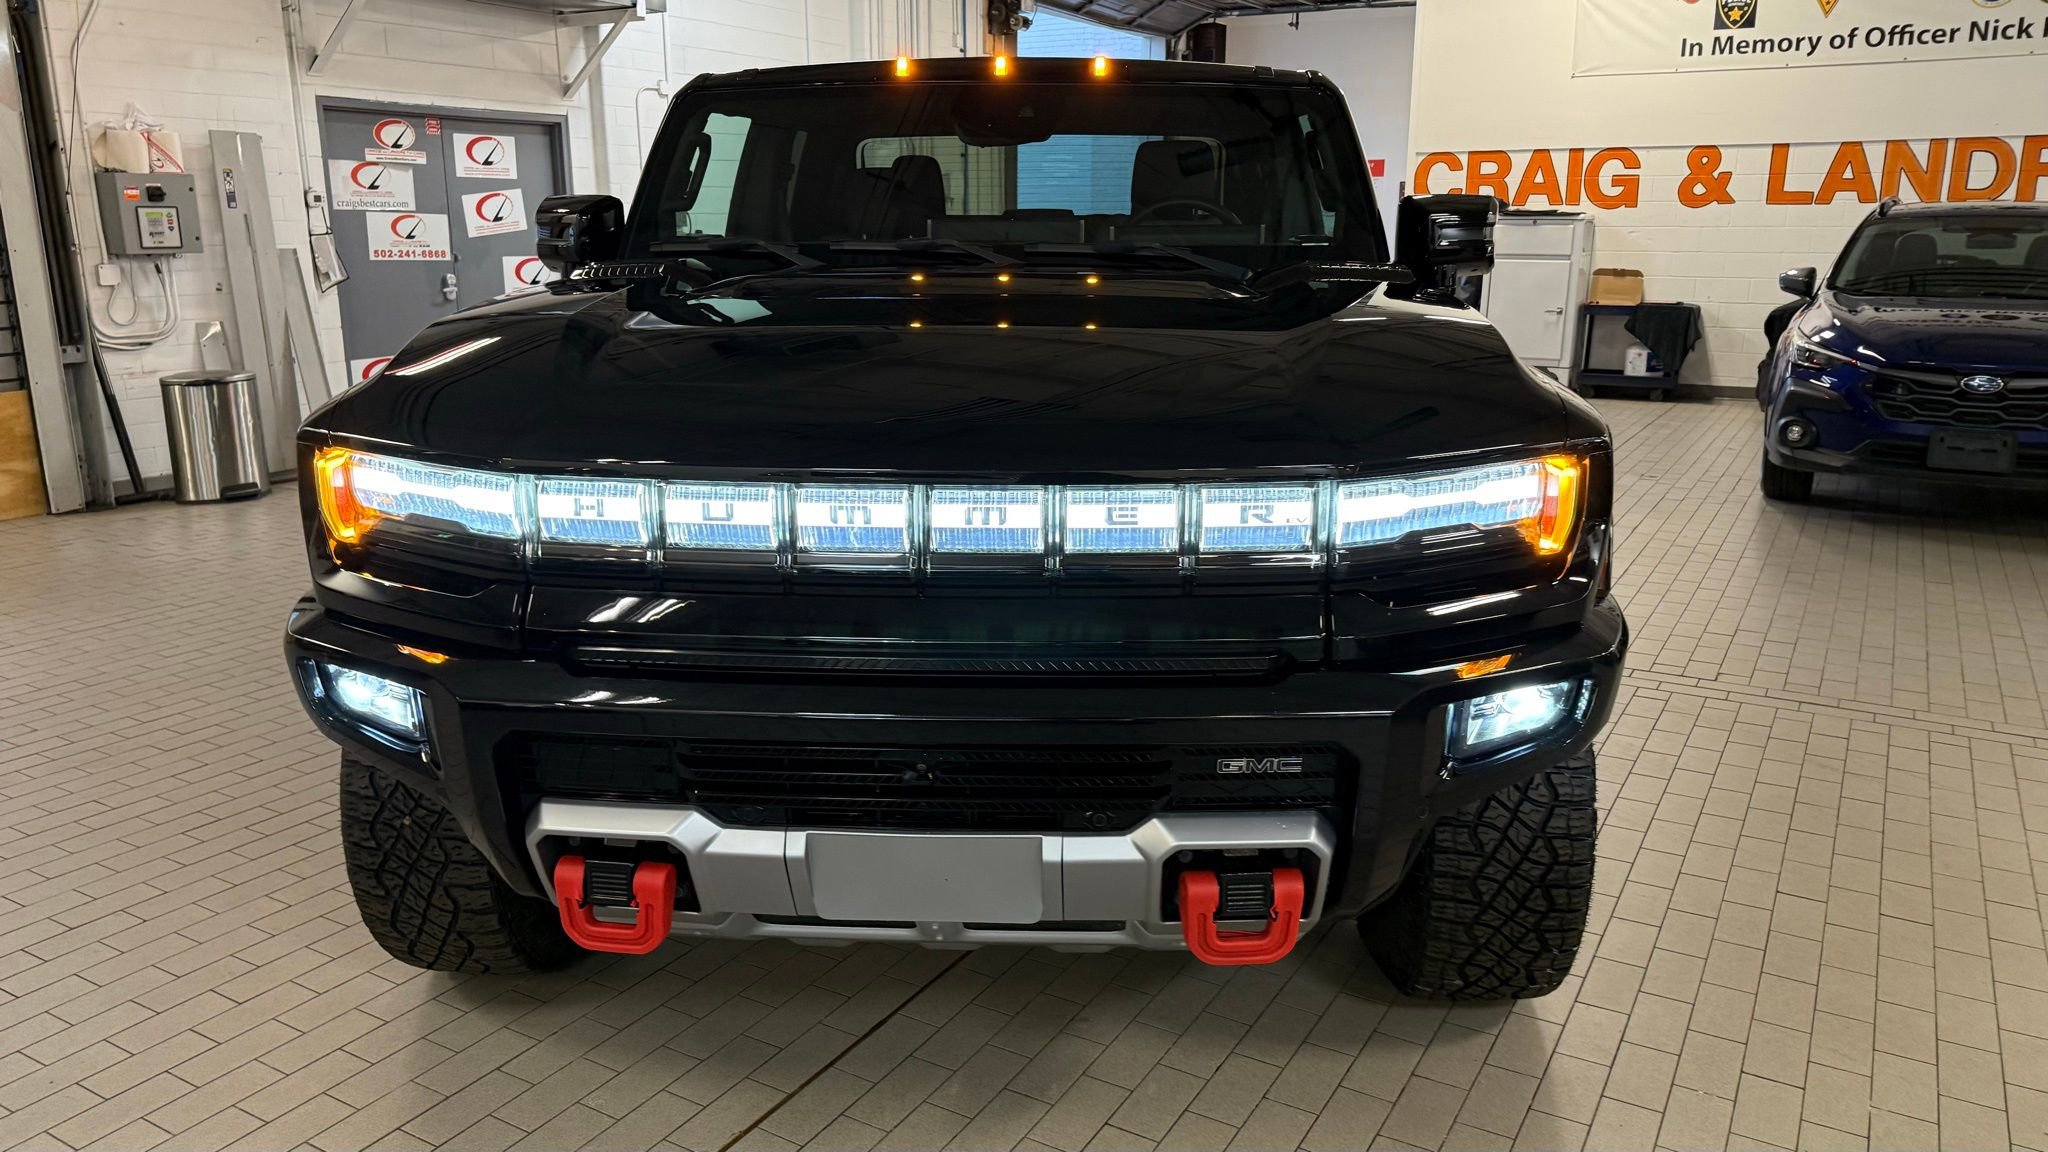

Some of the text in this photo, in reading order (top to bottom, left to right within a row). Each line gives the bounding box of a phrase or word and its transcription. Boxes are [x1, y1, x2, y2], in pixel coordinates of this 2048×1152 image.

[1680, 38, 1704, 57] In
[1711, 35, 1823, 57] Memory
[1829, 27, 1860, 49] of
[1865, 24, 1962, 48] Officer
[1968, 17, 2036, 42] Nick
[1413, 147, 1641, 209] CRAIG
[1678, 145, 1736, 208] &
[336, 198, 409, 209] craigsbestcars.com
[373, 249, 447, 259] 502-241-6868
[1216, 757, 1303, 774] GMC
